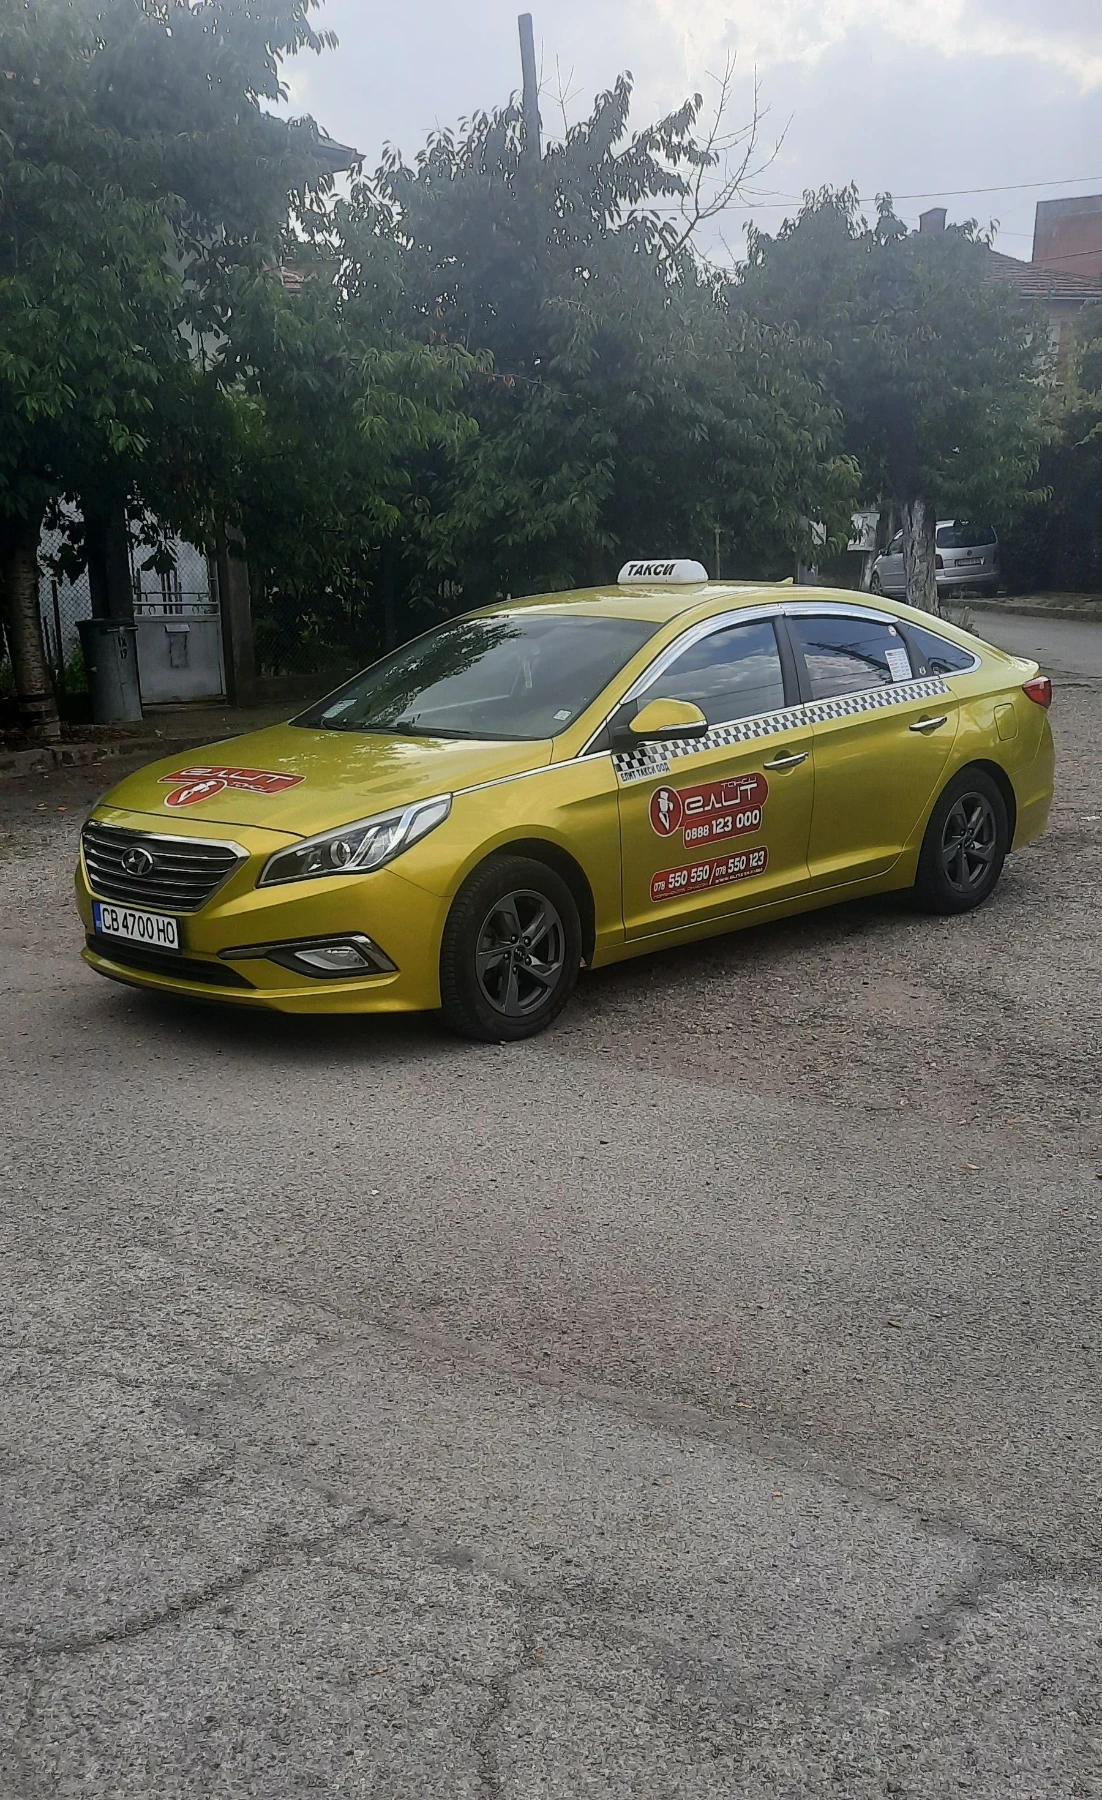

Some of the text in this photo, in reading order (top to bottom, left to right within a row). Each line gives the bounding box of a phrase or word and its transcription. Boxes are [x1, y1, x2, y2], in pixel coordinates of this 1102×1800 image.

[627, 563, 677, 576] ТАКСИ
[636, 765, 657, 777] ТАКСИ
[685, 809, 760, 841] 0888 123 000
[653, 881, 666, 892] 078
[668, 870, 688, 889] 550
[690, 864, 710, 883] 550
[715, 865, 727, 877] 078
[728, 855, 747, 873] 550
[749, 850, 765, 868] 123
